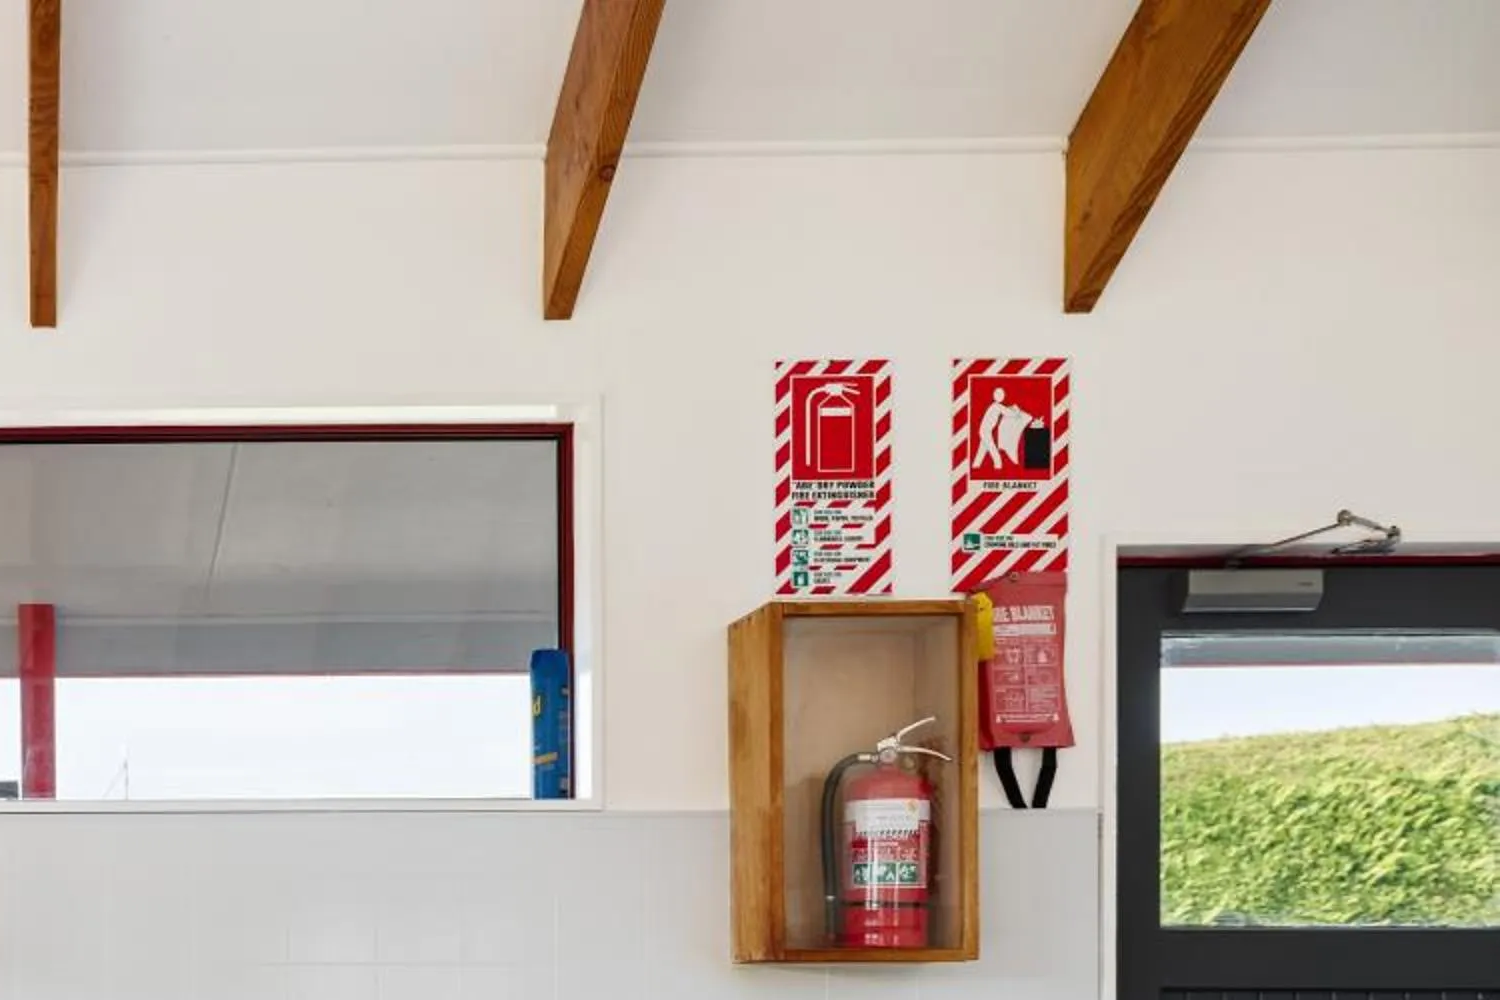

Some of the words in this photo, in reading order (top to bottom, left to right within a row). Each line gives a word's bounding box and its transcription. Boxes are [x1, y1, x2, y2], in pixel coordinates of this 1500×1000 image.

[983, 481, 999, 489] FIRE
[1002, 481, 1038, 489] BLANKET
[791, 491, 810, 499] FIRE
